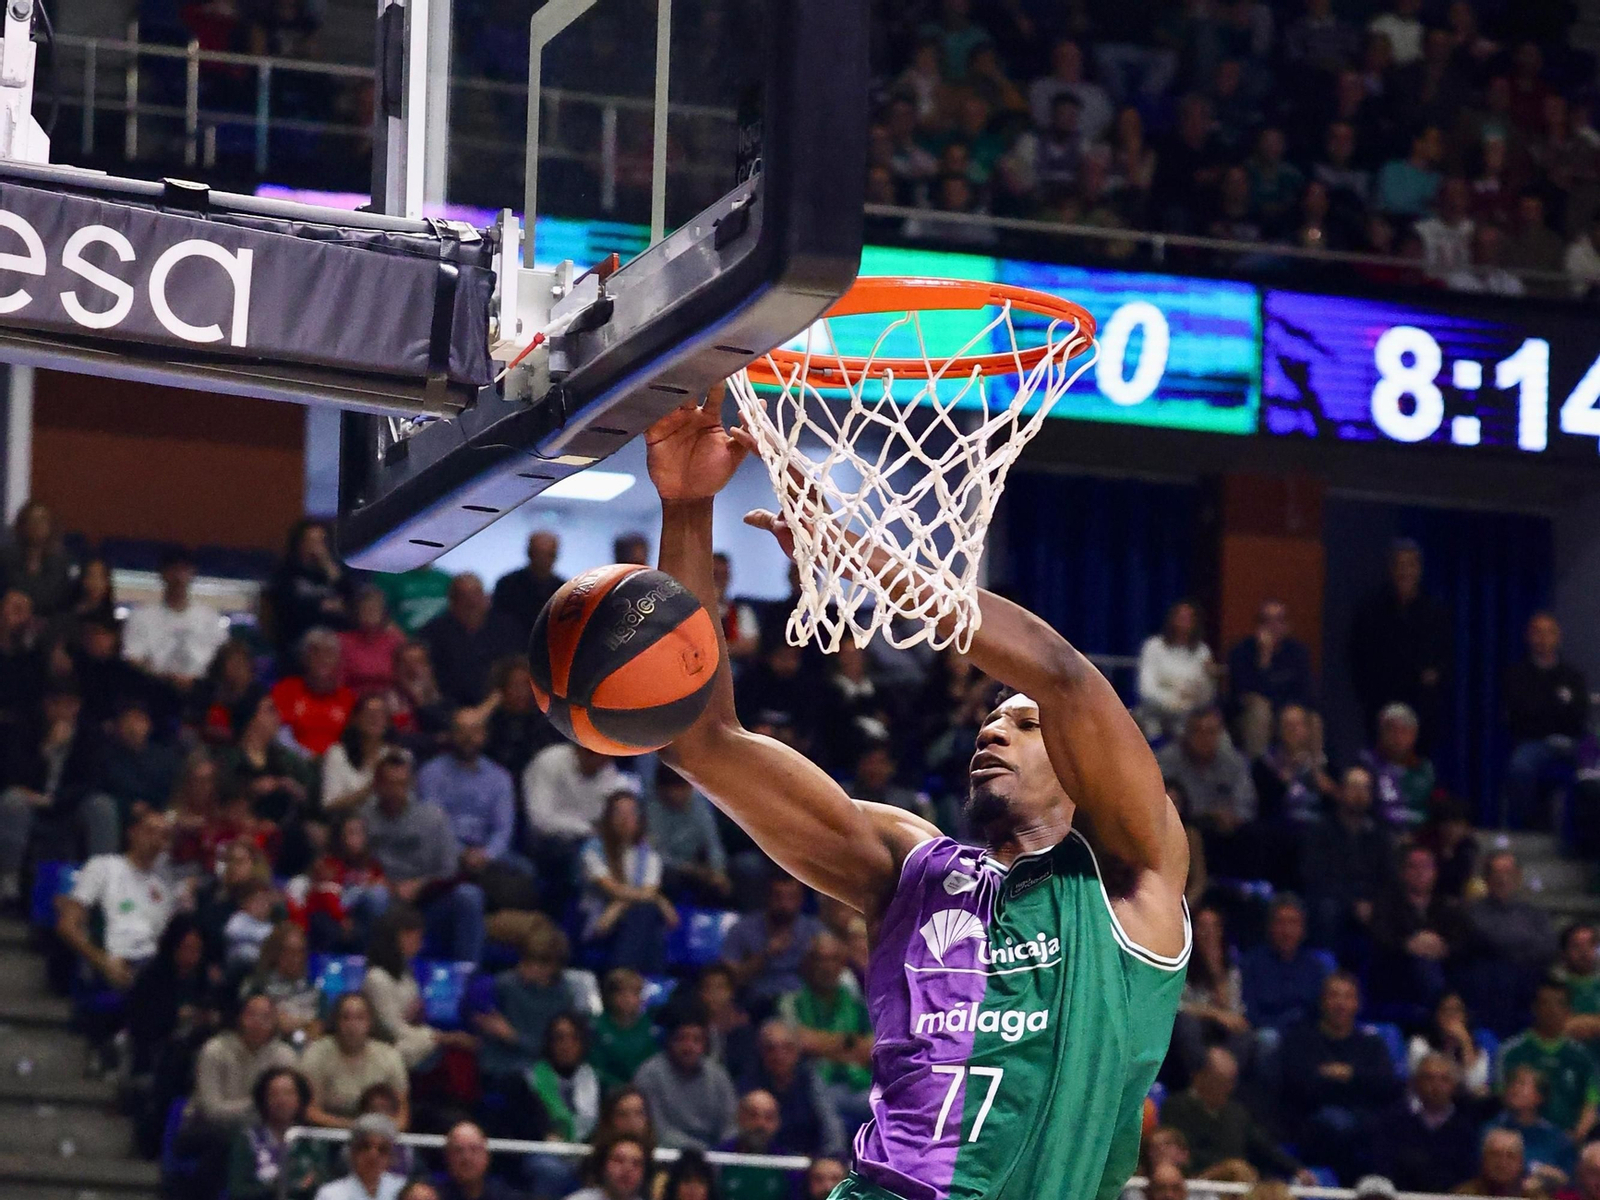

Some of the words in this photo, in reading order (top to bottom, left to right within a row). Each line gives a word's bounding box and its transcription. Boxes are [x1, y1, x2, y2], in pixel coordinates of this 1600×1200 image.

[1096, 302, 1170, 406] 0
[978, 932, 1060, 964] Unicaja
[915, 1002, 1049, 1042] málaga
[931, 1065, 1004, 1142] 77
